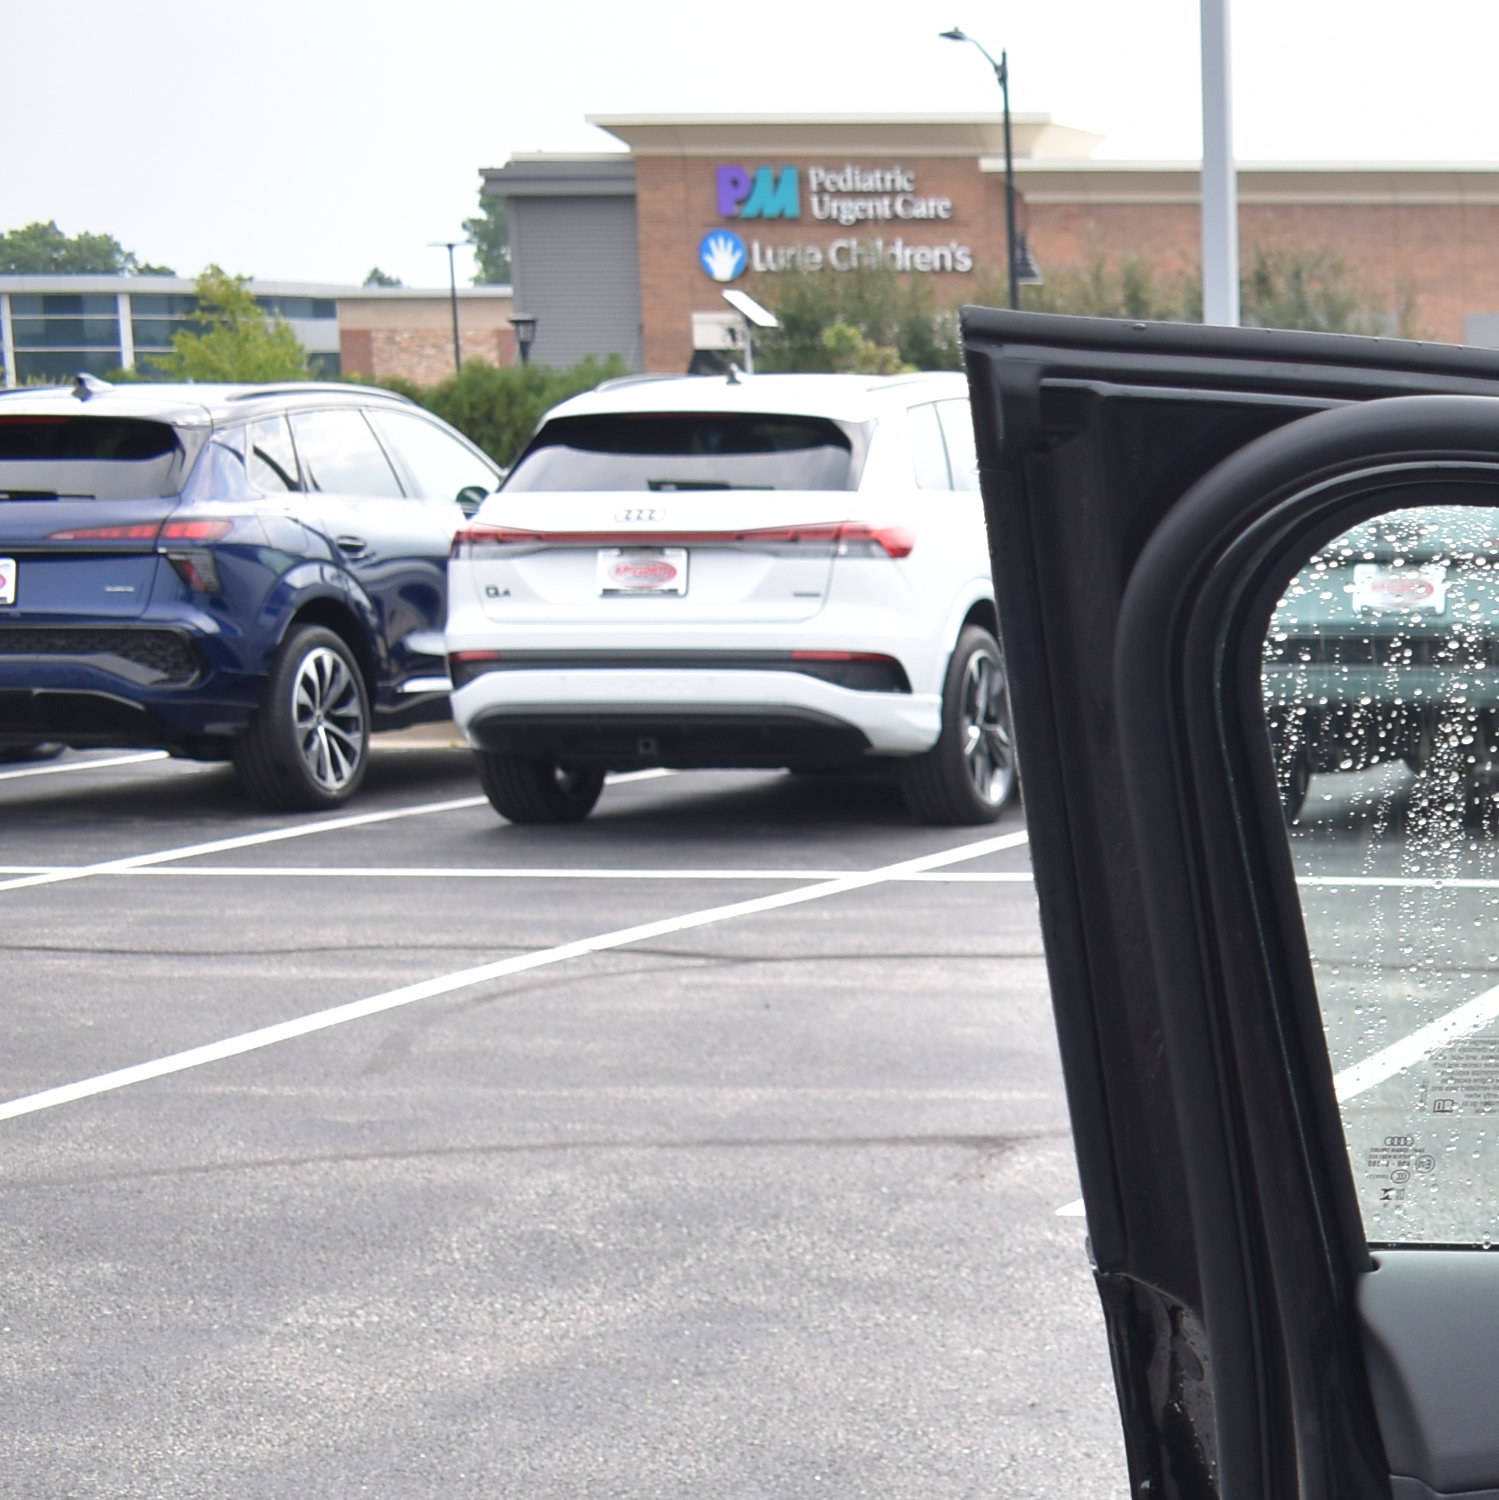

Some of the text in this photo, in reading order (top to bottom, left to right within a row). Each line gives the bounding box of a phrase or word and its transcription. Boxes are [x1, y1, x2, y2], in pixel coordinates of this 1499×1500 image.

[716, 165, 800, 218] PM
[808, 164, 915, 193] Pediatric
[809, 192, 952, 225] Urgent Care
